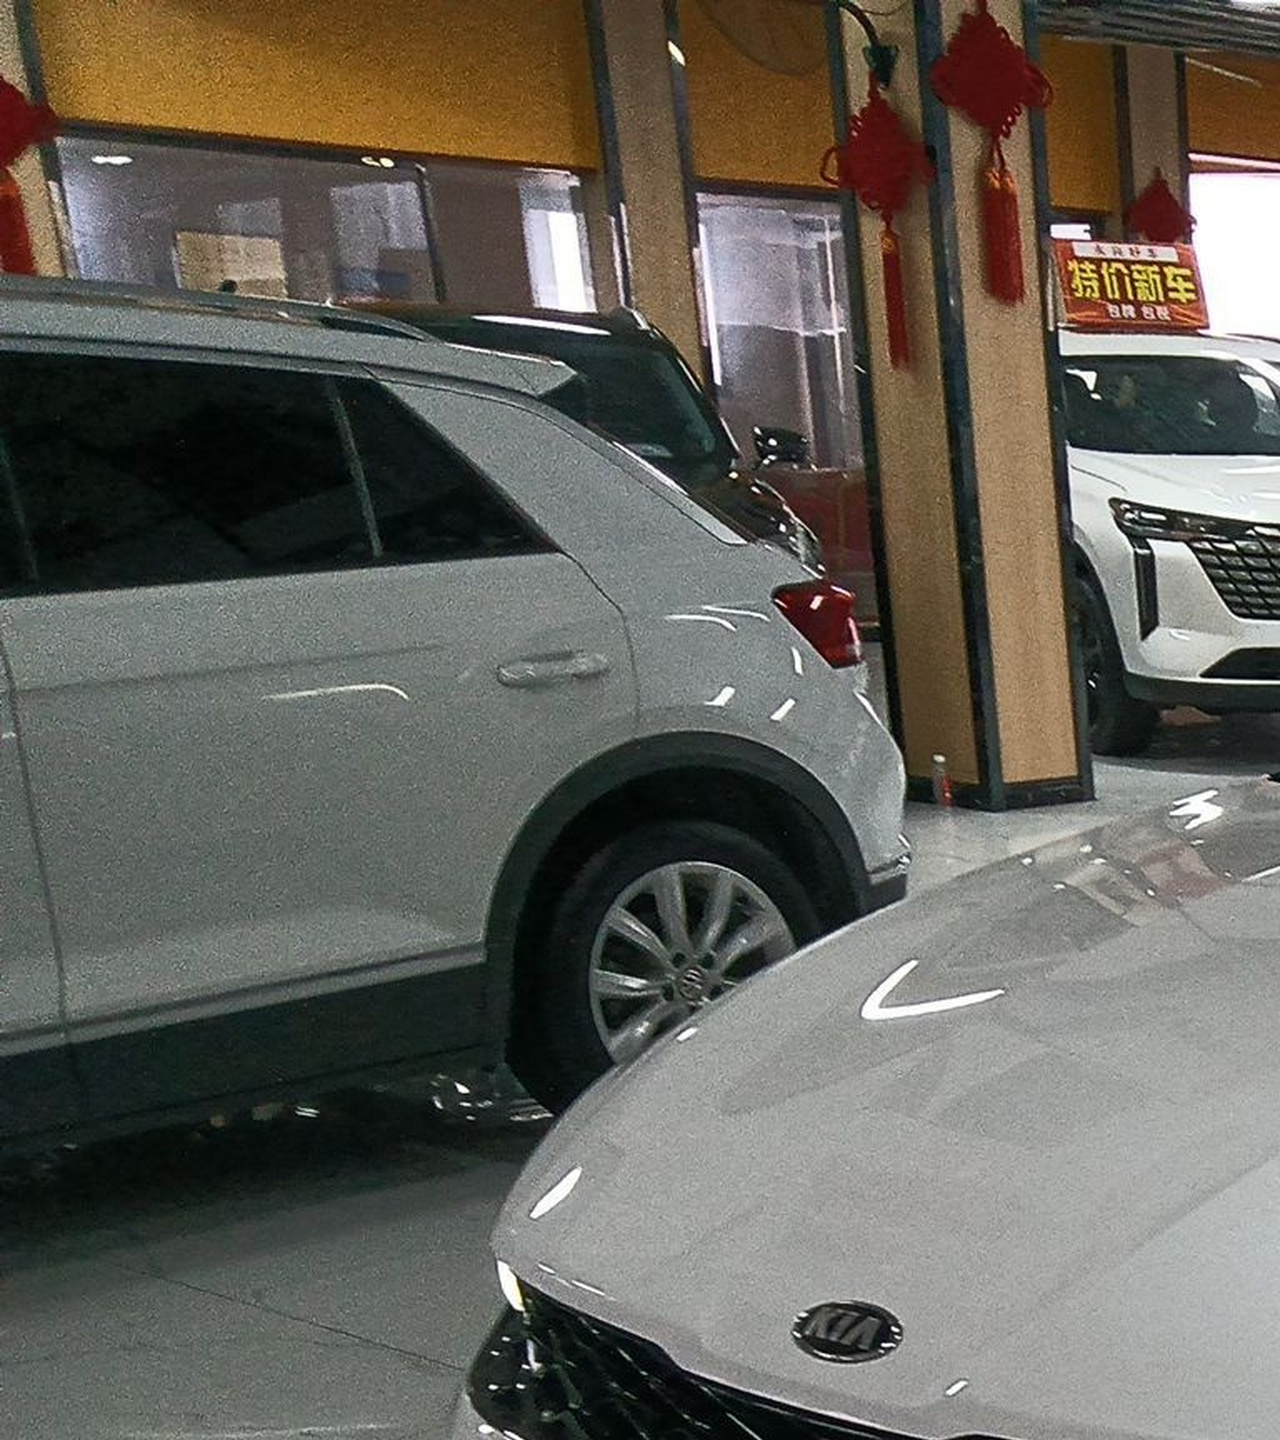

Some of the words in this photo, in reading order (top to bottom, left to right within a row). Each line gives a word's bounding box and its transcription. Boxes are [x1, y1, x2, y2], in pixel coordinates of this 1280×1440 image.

[1067, 259, 1197, 303] 特价新车
[804, 1306, 881, 1351] KIA
